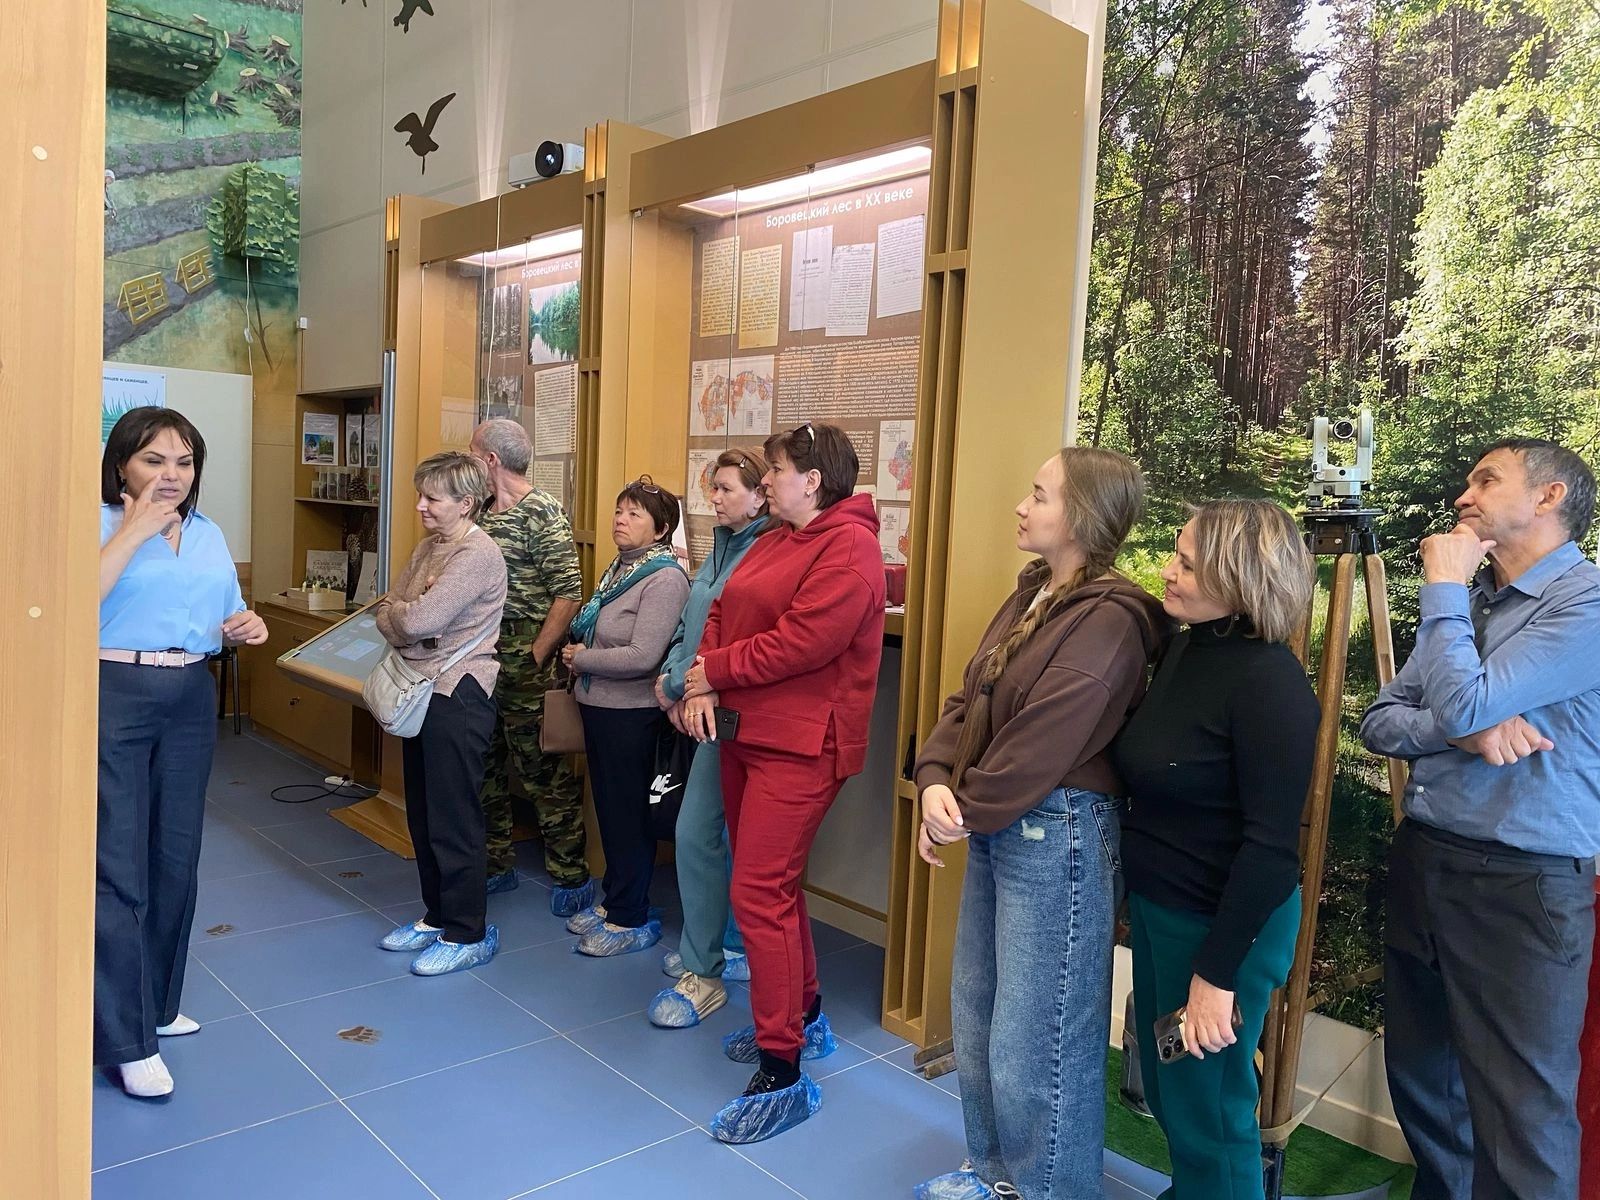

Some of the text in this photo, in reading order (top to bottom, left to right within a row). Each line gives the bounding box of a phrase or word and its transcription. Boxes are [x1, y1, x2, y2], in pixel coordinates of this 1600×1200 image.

[766, 202, 829, 228] Боровецкий
[831, 201, 853, 214] лес
[855, 199, 861, 208] в
[884, 187, 913, 202] веке
[521, 262, 560, 280] Боровецкий
[561, 261, 573, 271] лес
